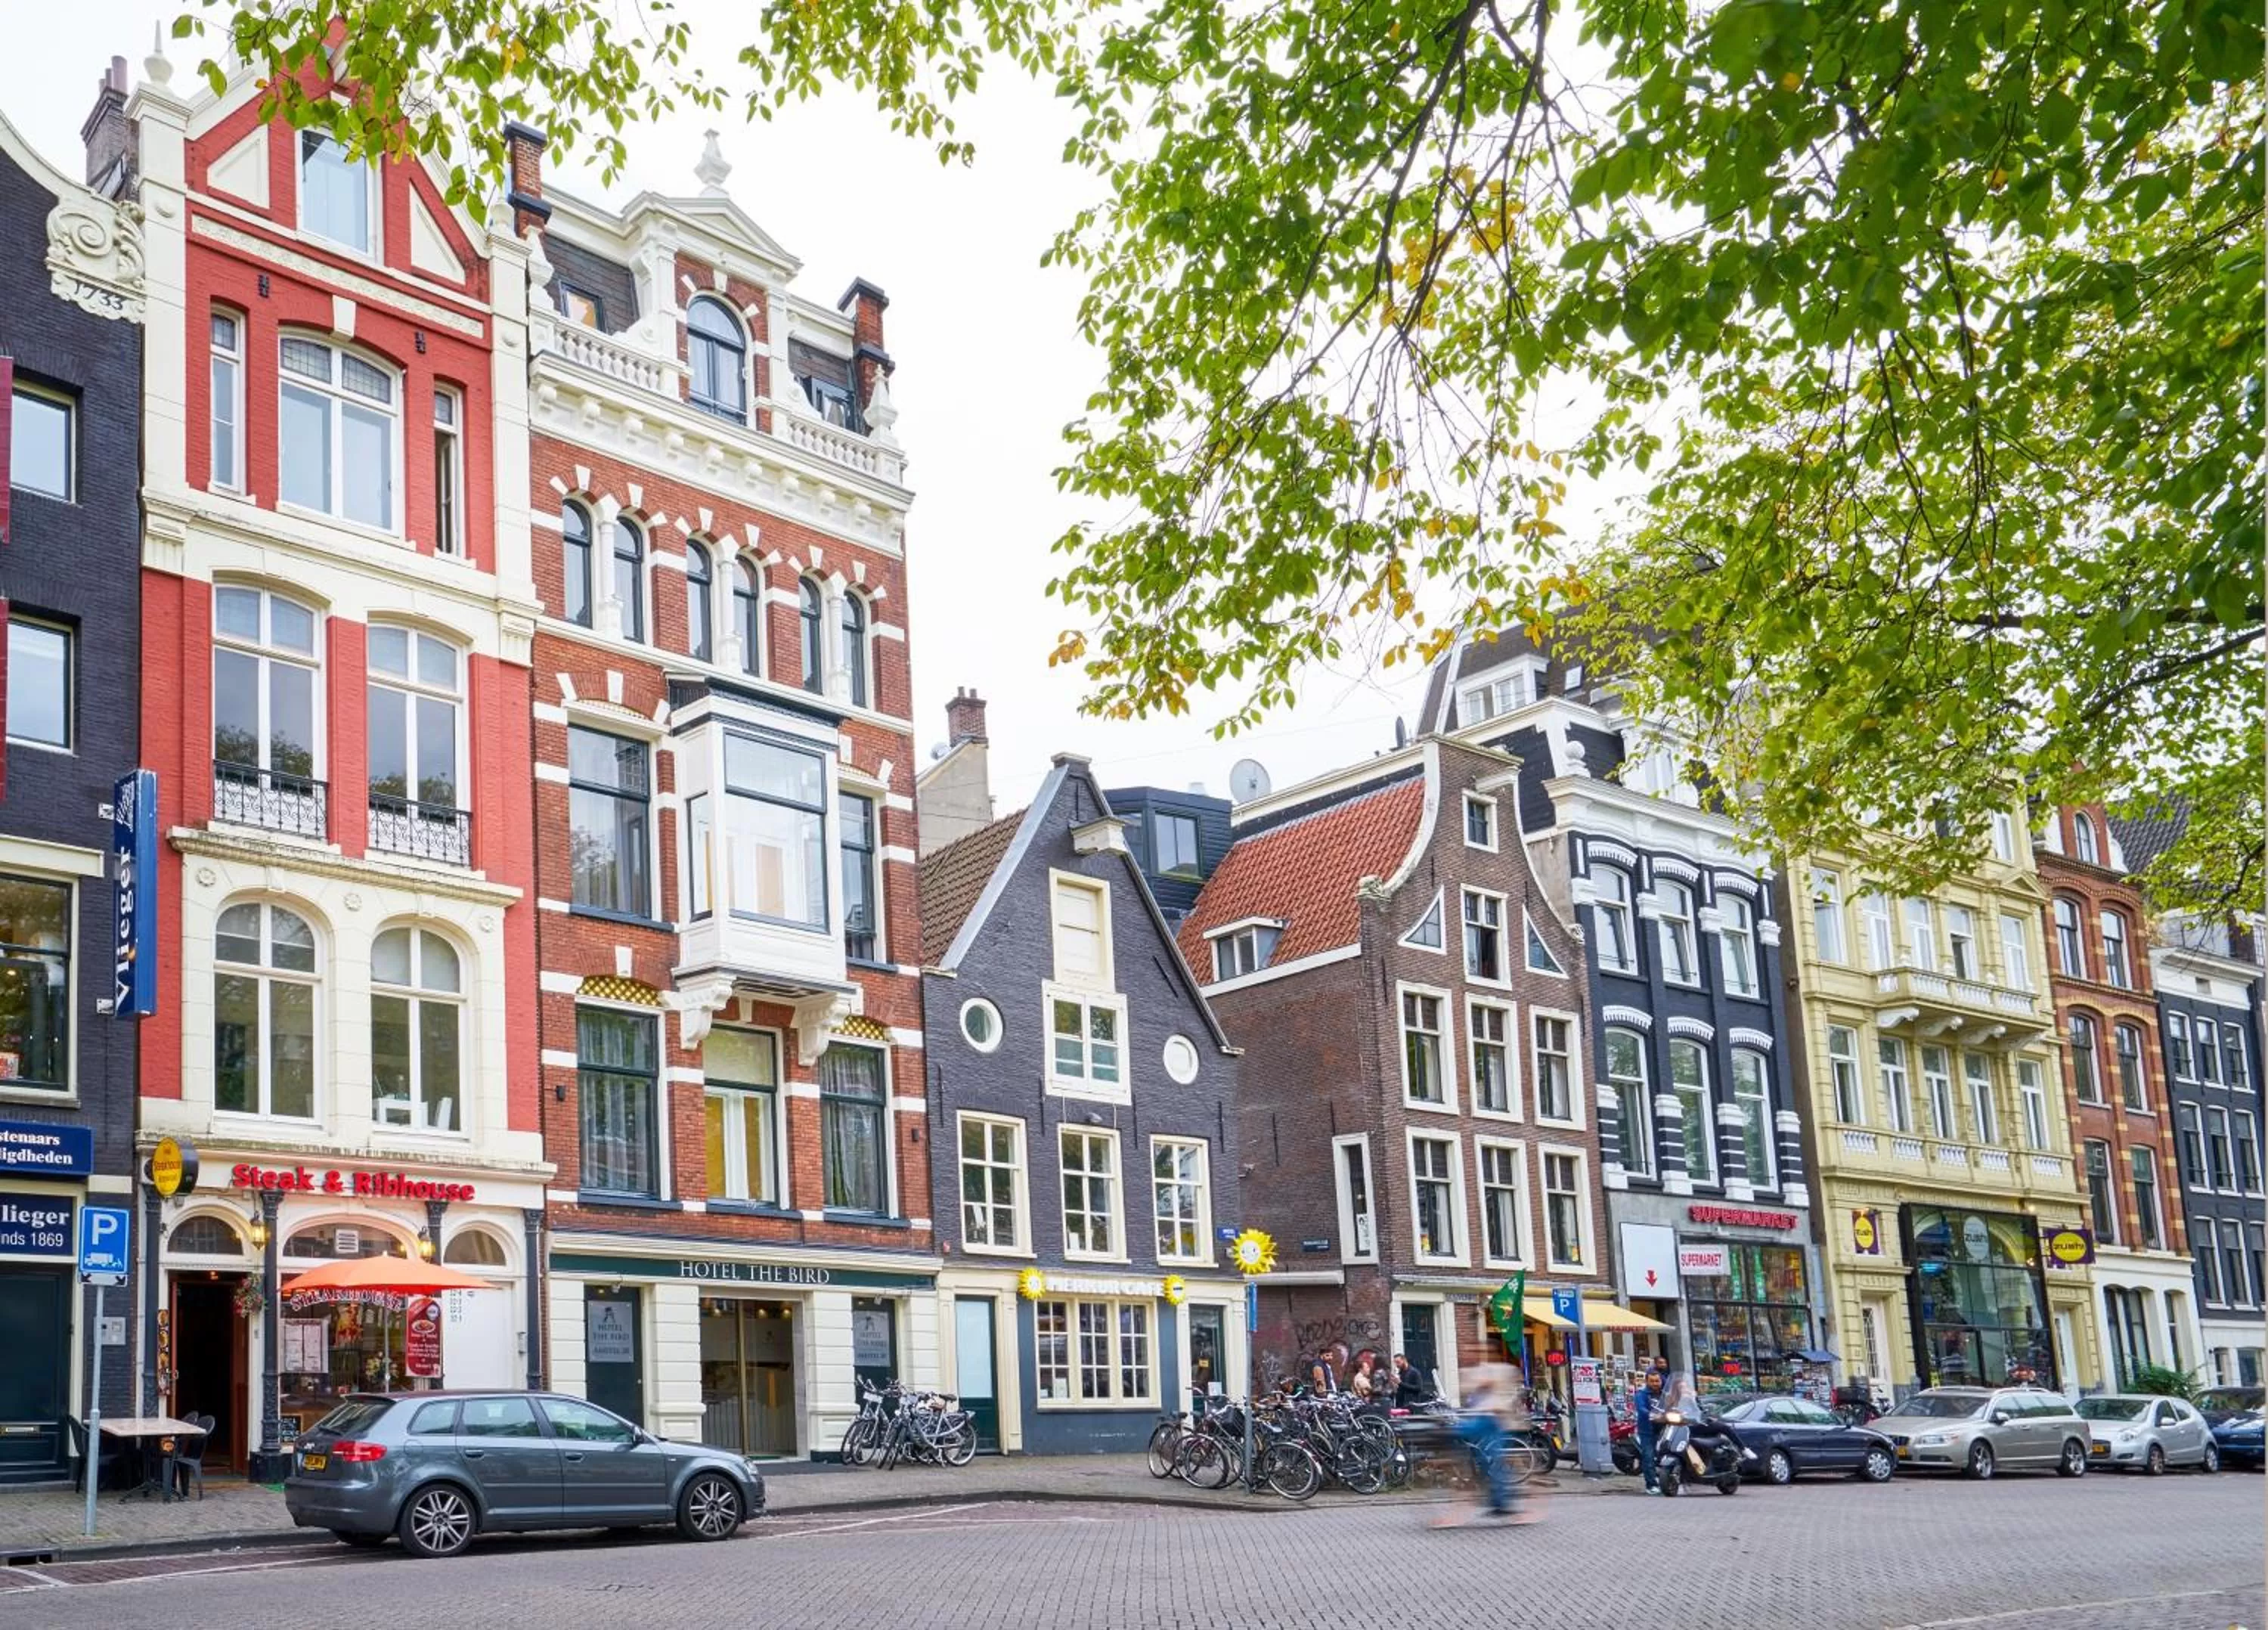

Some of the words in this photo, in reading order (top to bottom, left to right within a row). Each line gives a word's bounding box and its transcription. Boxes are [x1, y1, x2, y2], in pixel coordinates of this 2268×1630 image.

[73, 280, 123, 310] 1733
[116, 846, 134, 1011] Vlieger
[232, 1164, 314, 1191] Steak
[323, 1170, 343, 1193] &
[352, 1171, 475, 1201] Ribhouse
[2, 1204, 70, 1229] lieger
[1690, 1205, 1799, 1231] SUPERMARKET
[31, 1231, 64, 1247] 1869
[91, 1213, 118, 1246] P
[680, 1260, 741, 1280] HOTEL
[747, 1266, 782, 1282] THE
[789, 1268, 830, 1284] BIRD
[1681, 1252, 1722, 1268] SUPERMARKET
[1560, 1298, 1570, 1313] P
